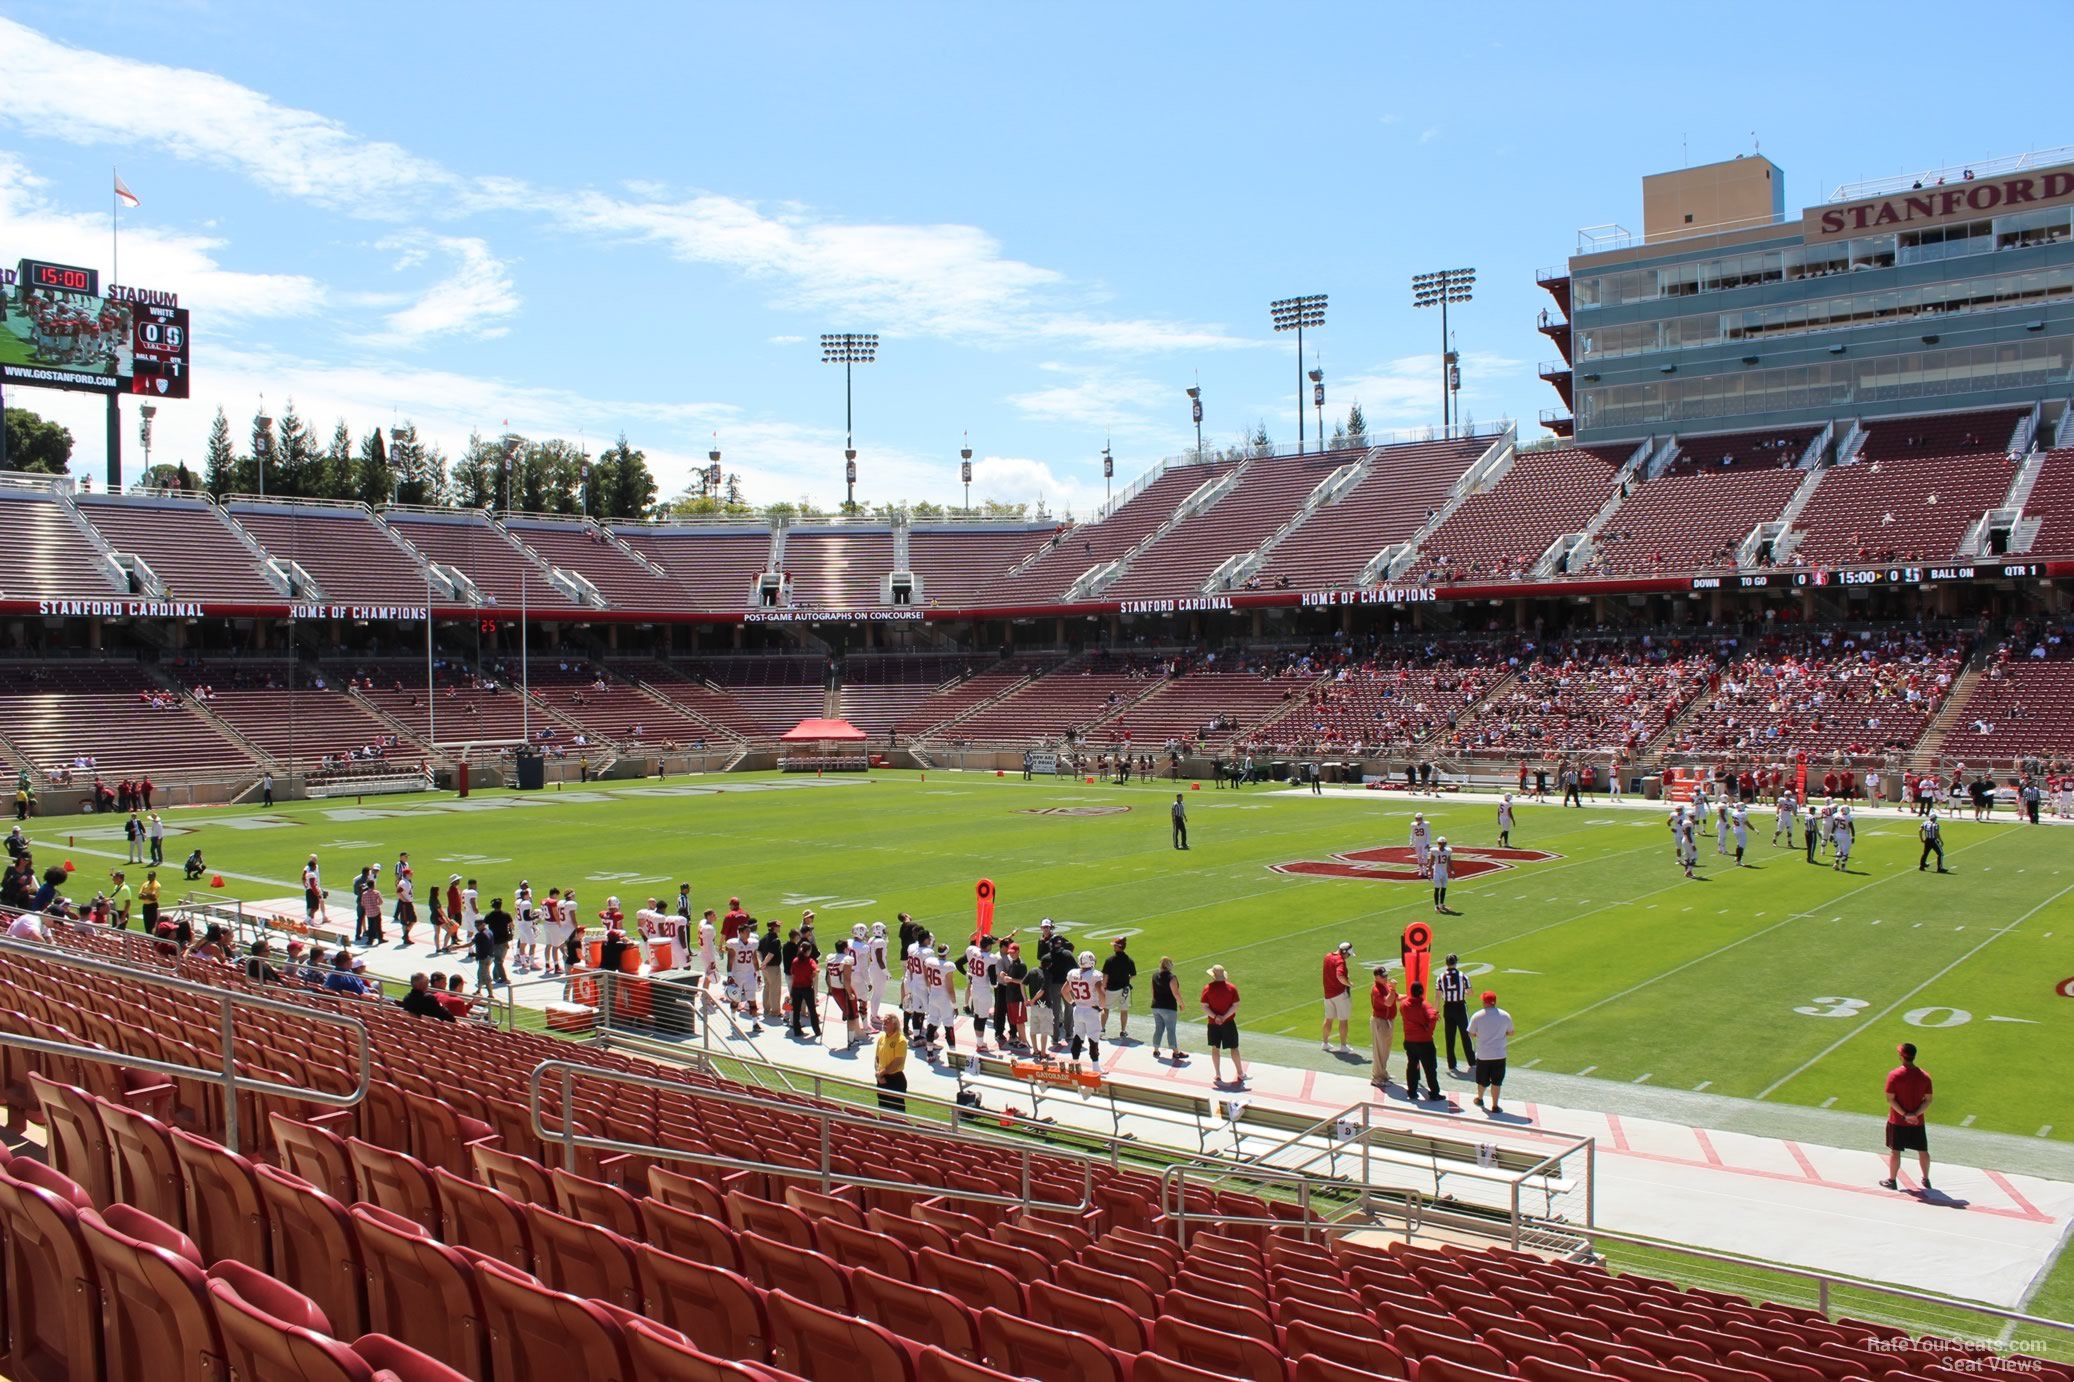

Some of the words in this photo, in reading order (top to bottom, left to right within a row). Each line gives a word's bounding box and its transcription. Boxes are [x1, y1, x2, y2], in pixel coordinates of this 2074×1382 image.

[1821, 171, 2074, 235] STANFORD
[41, 267, 85, 288] 15:00
[107, 283, 178, 308] STADIUM
[149, 306, 175, 318] WHITE
[4, 366, 117, 387] WWW.GOSTANFORD.COM
[172, 364, 179, 377] 1
[1890, 571, 1898, 582] 0
[1931, 568, 1957, 579] BALL
[1959, 568, 1974, 578] ON
[2004, 565, 2026, 576] QTR
[2030, 564, 2037, 575] 1
[1693, 578, 1720, 588] DOWN
[1740, 577, 1752, 586] TO
[1754, 576, 1767, 586] GO
[1798, 574, 1806, 585] 0
[1838, 571, 1876, 584] 15:00
[1302, 592, 1336, 606] HOME
[1341, 591, 1357, 604] OF
[1360, 588, 1436, 604] CHAMPIONS
[39, 601, 123, 615] STANFORD
[129, 602, 204, 616] CARDINAL
[1120, 600, 1174, 613] STANFORD
[1178, 597, 1233, 611] CARDINAL
[289, 605, 326, 618] HOME
[331, 606, 347, 619] OF
[352, 606, 427, 620] CHAMPIONS
[744, 612, 793, 622] POST-GAME
[795, 612, 853, 621] AUTOGRAPHS
[854, 612, 868, 621] ON
[870, 611, 924, 621] CONCOURSE!
[481, 619, 496, 633] 25
[1437, 854, 1447, 865] 13
[584, 872, 674, 885] 30
[780, 894, 878, 910] 40
[737, 950, 754, 964] 33
[968, 958, 985, 977] 48
[1446, 975, 1457, 989] L
[1071, 981, 1092, 1000] 53
[1792, 996, 1973, 1028] 30
[1035, 1071, 1070, 1081] GATORADE
